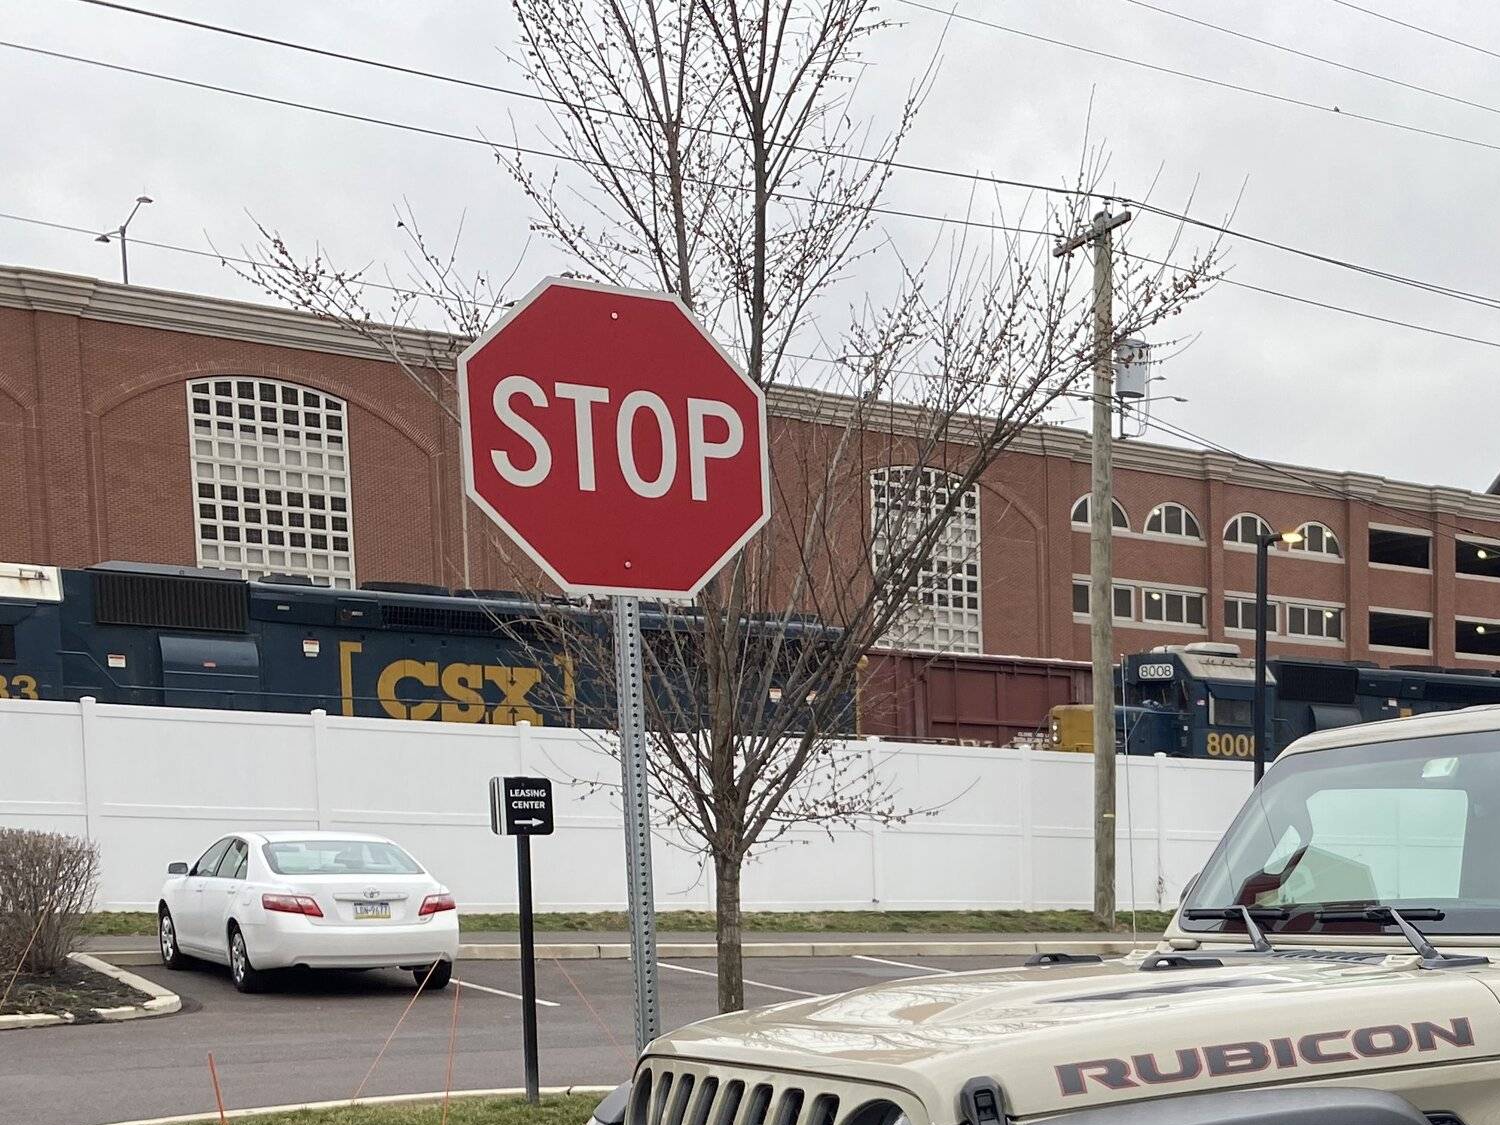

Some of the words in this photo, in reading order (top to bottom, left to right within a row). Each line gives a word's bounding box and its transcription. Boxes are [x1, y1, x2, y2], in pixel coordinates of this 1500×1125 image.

[491, 375, 744, 502] STOP
[1141, 666, 1172, 677] 8008
[377, 659, 543, 727] CSX
[510, 789, 547, 797] LEASING
[512, 801, 546, 809] CENTER
[1053, 1017, 1475, 1096] RUBICON
